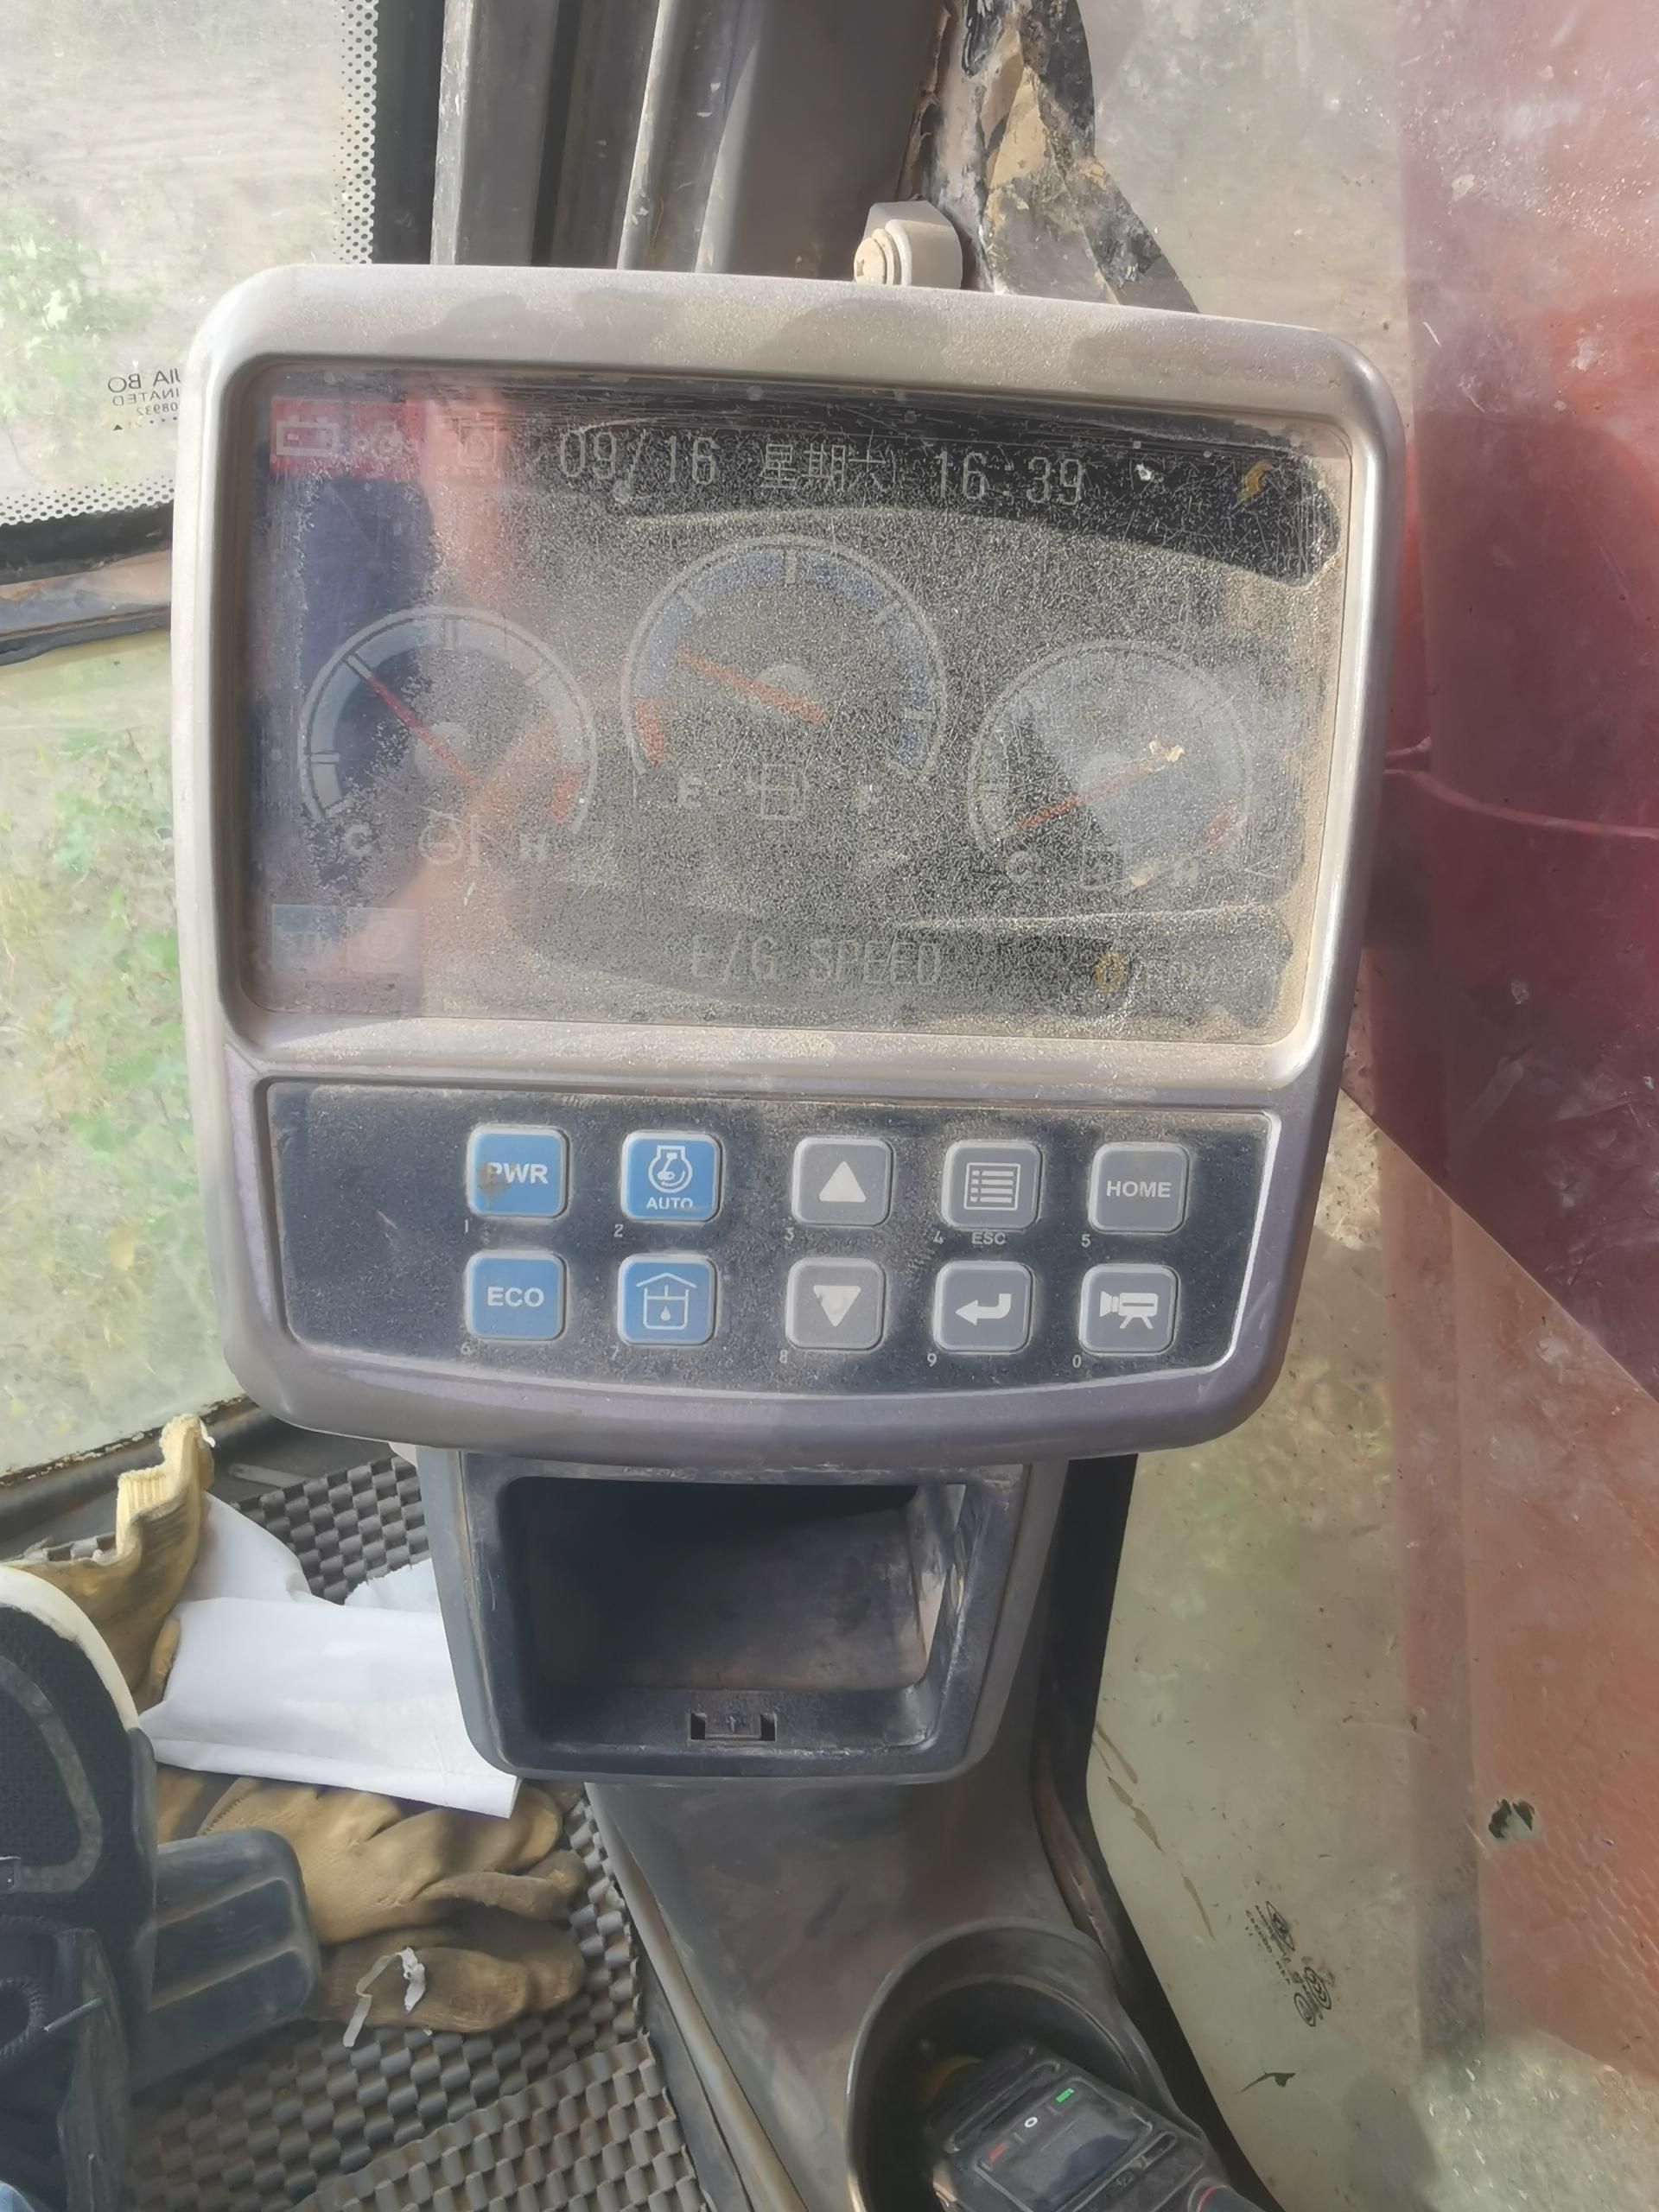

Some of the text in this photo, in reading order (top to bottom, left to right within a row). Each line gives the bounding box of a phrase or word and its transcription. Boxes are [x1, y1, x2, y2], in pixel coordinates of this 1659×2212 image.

[559, 431, 719, 486] 09/16
[936, 449, 1084, 505] 16:39
[486, 1161, 549, 1185] PWR
[1106, 1179, 1173, 1198] HOME
[646, 1196, 694, 1211] AUTO
[613, 1224, 624, 1238] 2
[784, 1227, 795, 1242] 3
[932, 1230, 944, 1245] 4
[970, 1230, 1007, 1246] ESC
[1081, 1234, 1091, 1248] 5
[486, 1285, 545, 1308] ECO
[779, 1349, 788, 1364] 8
[926, 1352, 938, 1367] 9
